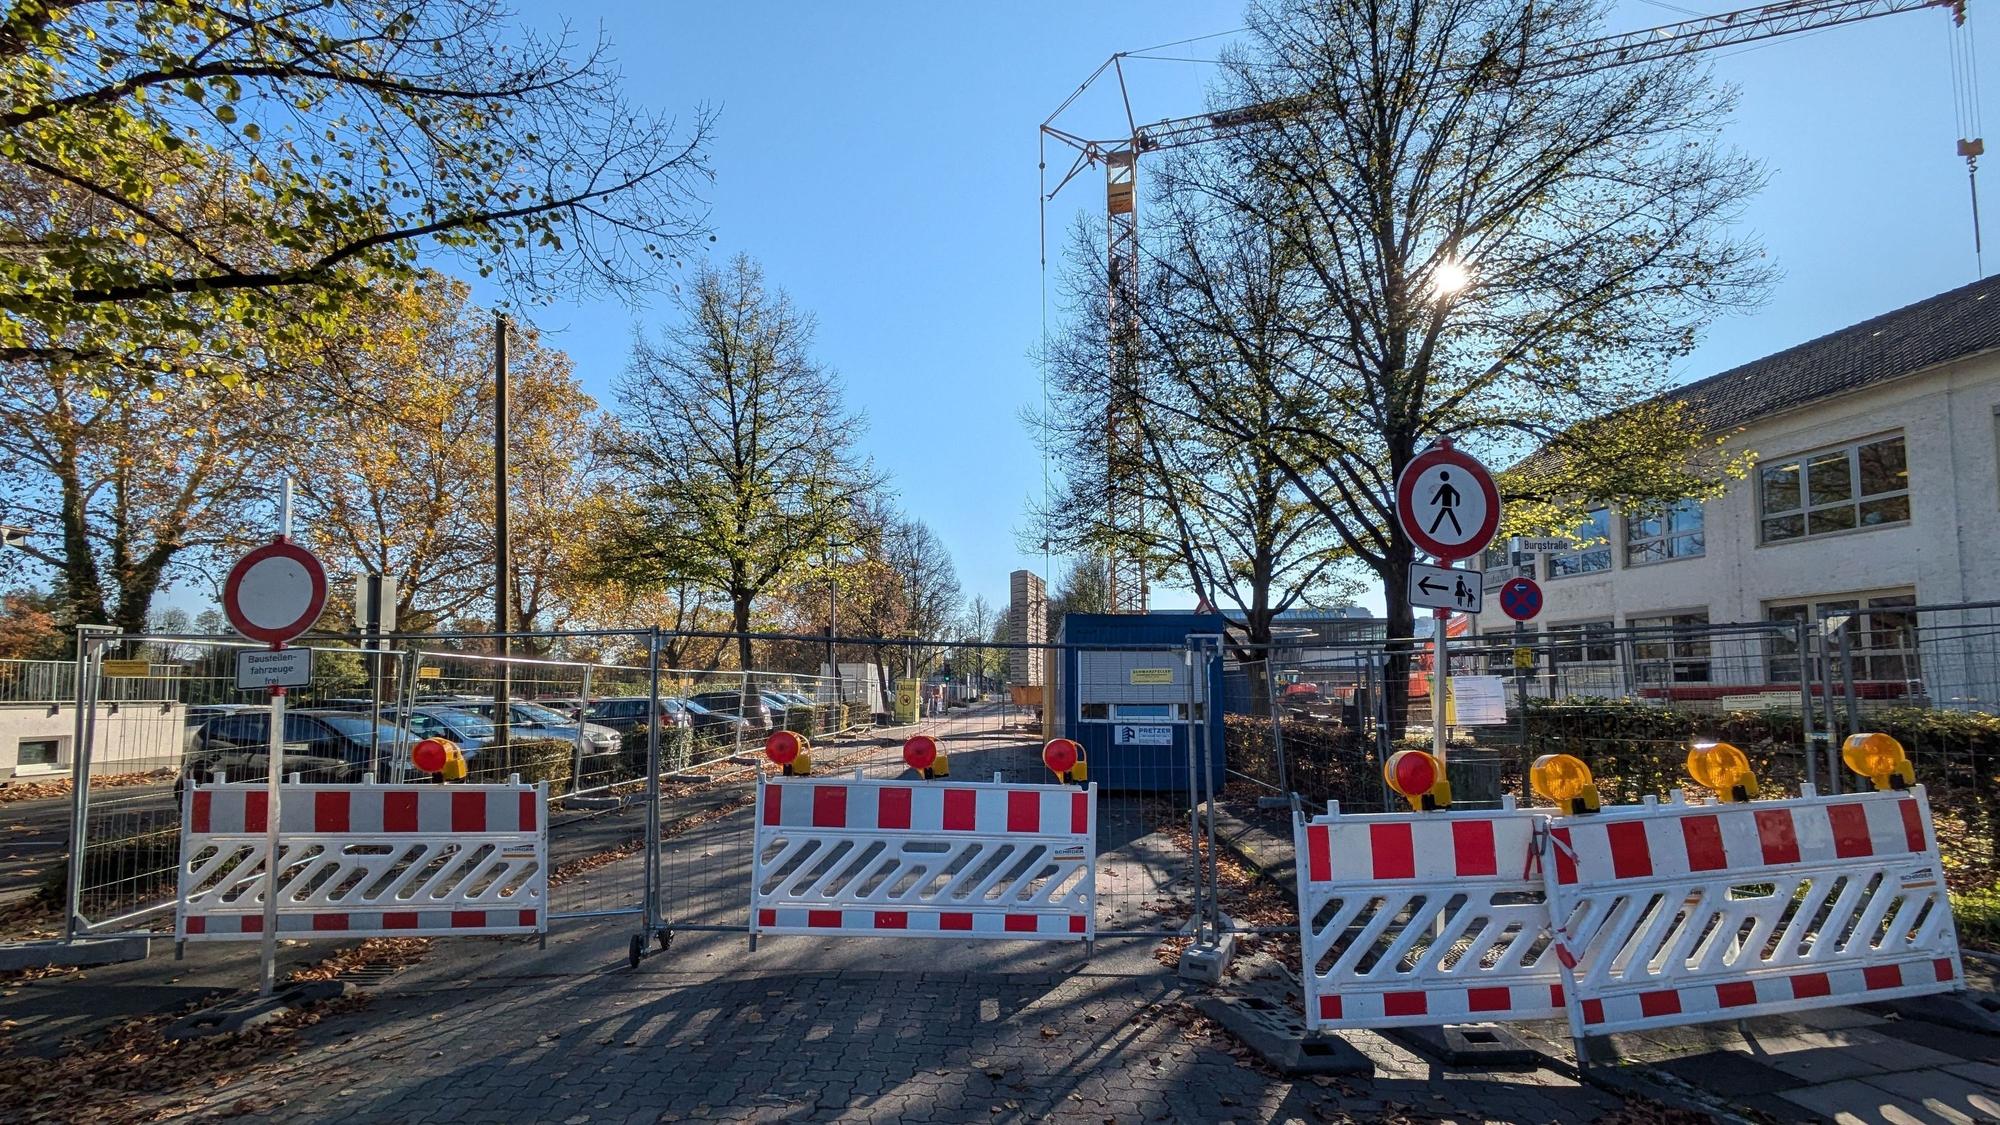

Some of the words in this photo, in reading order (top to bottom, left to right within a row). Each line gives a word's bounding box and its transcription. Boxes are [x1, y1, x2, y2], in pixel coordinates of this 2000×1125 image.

[1524, 540, 1568, 552] Burgstraße
[248, 653, 297, 663] Baustellen-
[251, 665, 294, 675] fahrzeuge
[265, 676, 279, 685] frei
